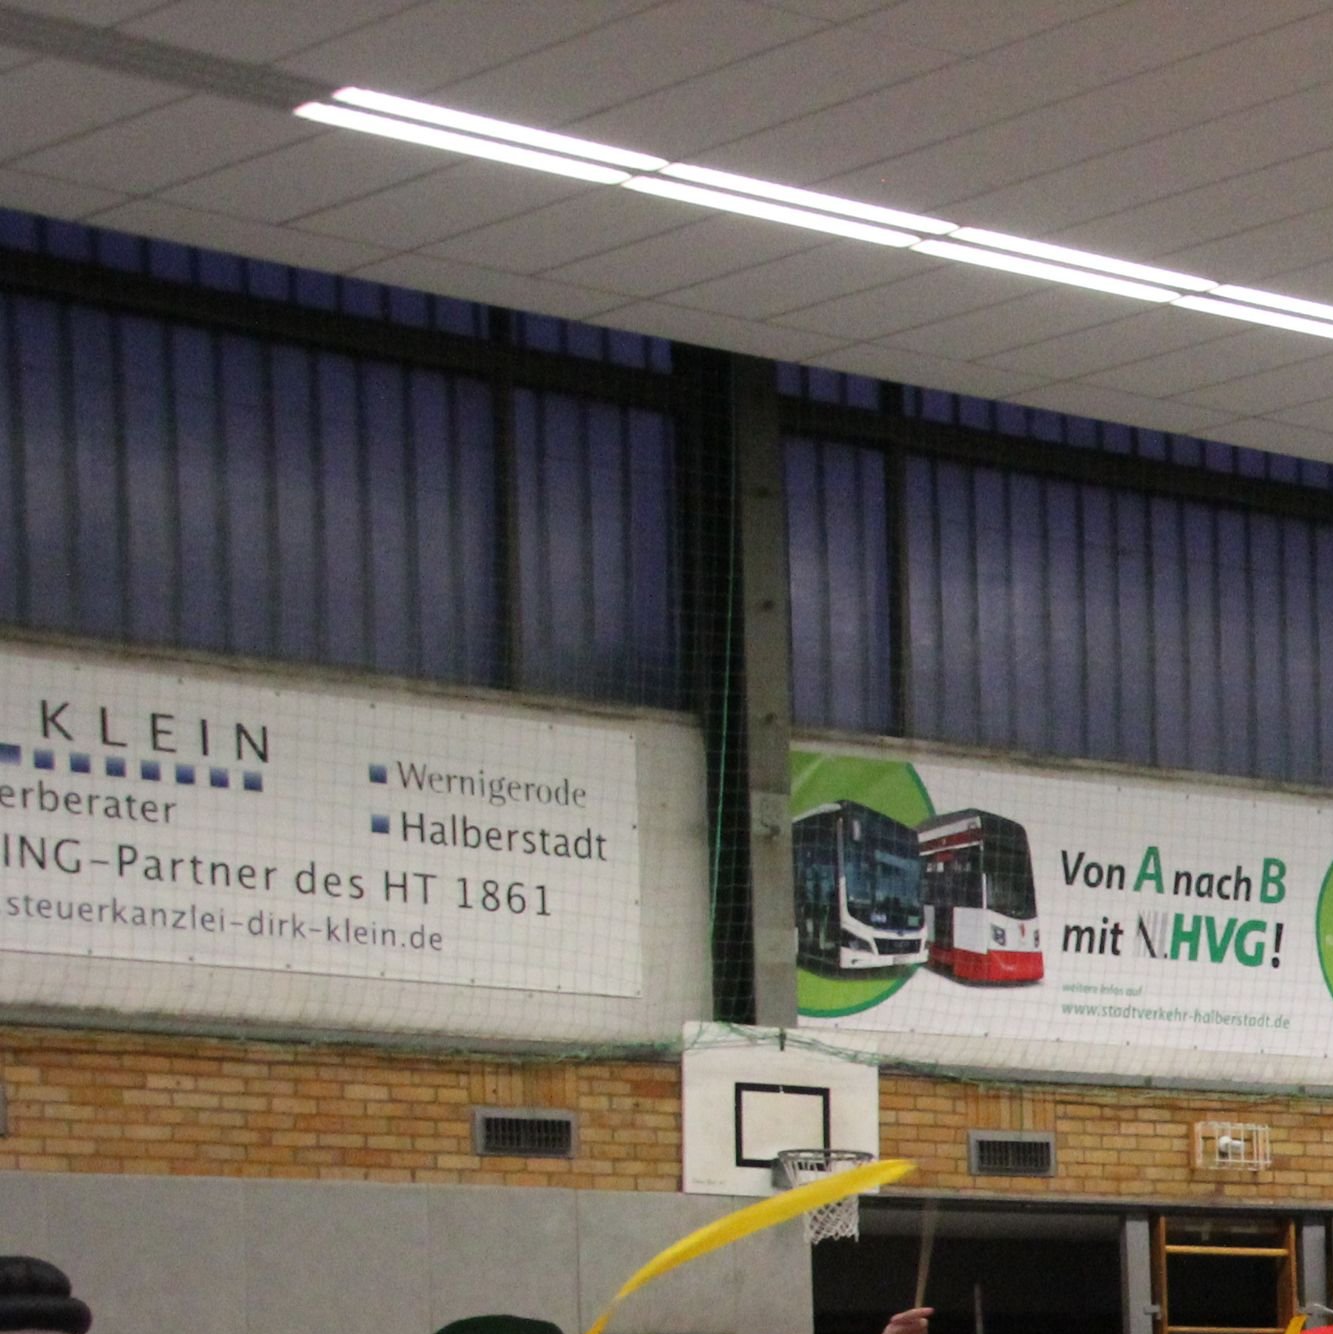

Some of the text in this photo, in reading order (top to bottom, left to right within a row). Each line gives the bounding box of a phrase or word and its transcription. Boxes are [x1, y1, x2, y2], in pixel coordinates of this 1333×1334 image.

[41, 699, 270, 763] KLEIN
[0, 779, 177, 823] erberater
[397, 760, 587, 808] Wernigerode
[401, 811, 608, 862] Halberstadt
[295, 861, 365, 900] des
[384, 869, 438, 905] HT
[456, 877, 552, 916] 1861
[1061, 846, 1288, 904] Von A nach B
[6, 895, 443, 951] steuerkanzlei-dirk-klein.de
[1062, 916, 1125, 956] mit
[1060, 1001, 1291, 1030] www.stadtverkehr-halberstadt.de
